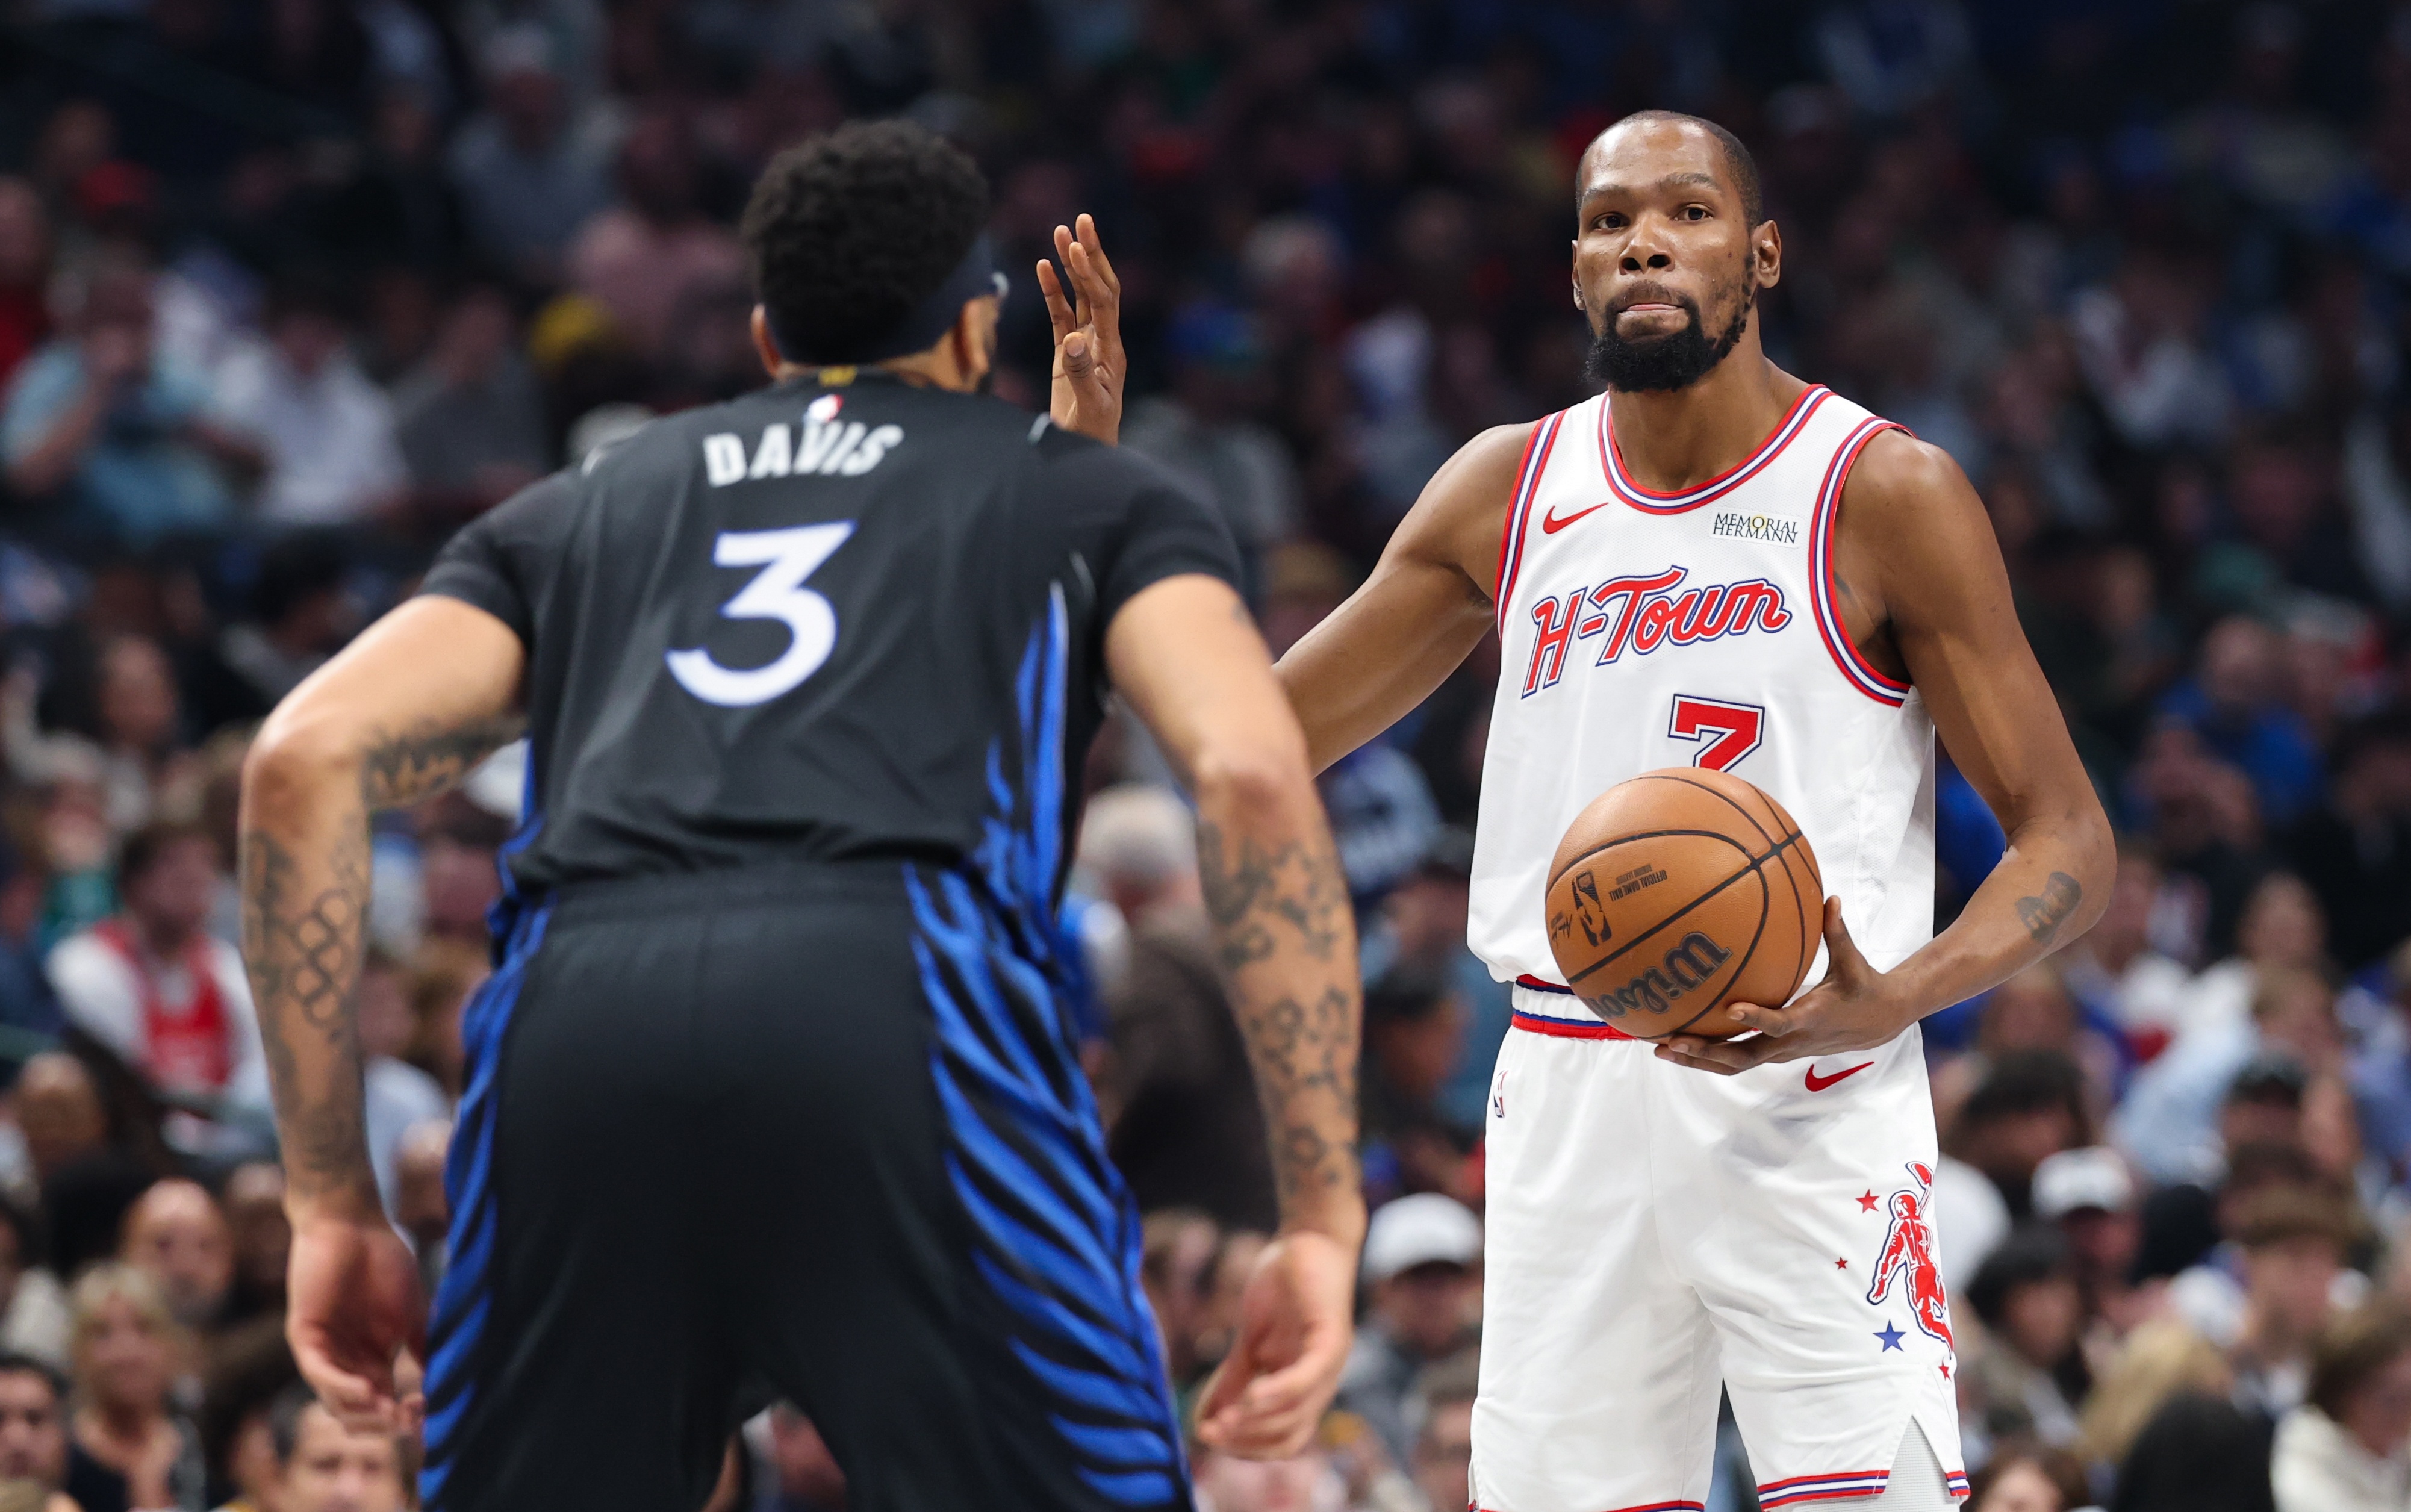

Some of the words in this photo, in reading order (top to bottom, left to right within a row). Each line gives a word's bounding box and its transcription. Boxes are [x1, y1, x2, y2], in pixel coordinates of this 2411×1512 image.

[703, 420, 904, 486] DAVIS
[1713, 523, 1798, 544] HERMANN
[1714, 512, 1798, 534] MEMORIAL
[664, 519, 858, 708] 3
[1521, 565, 1792, 699] H-Town
[1668, 694, 1765, 773] 7
[1622, 880, 1641, 896] GAME
[1639, 870, 1667, 888] OFFICIAL
